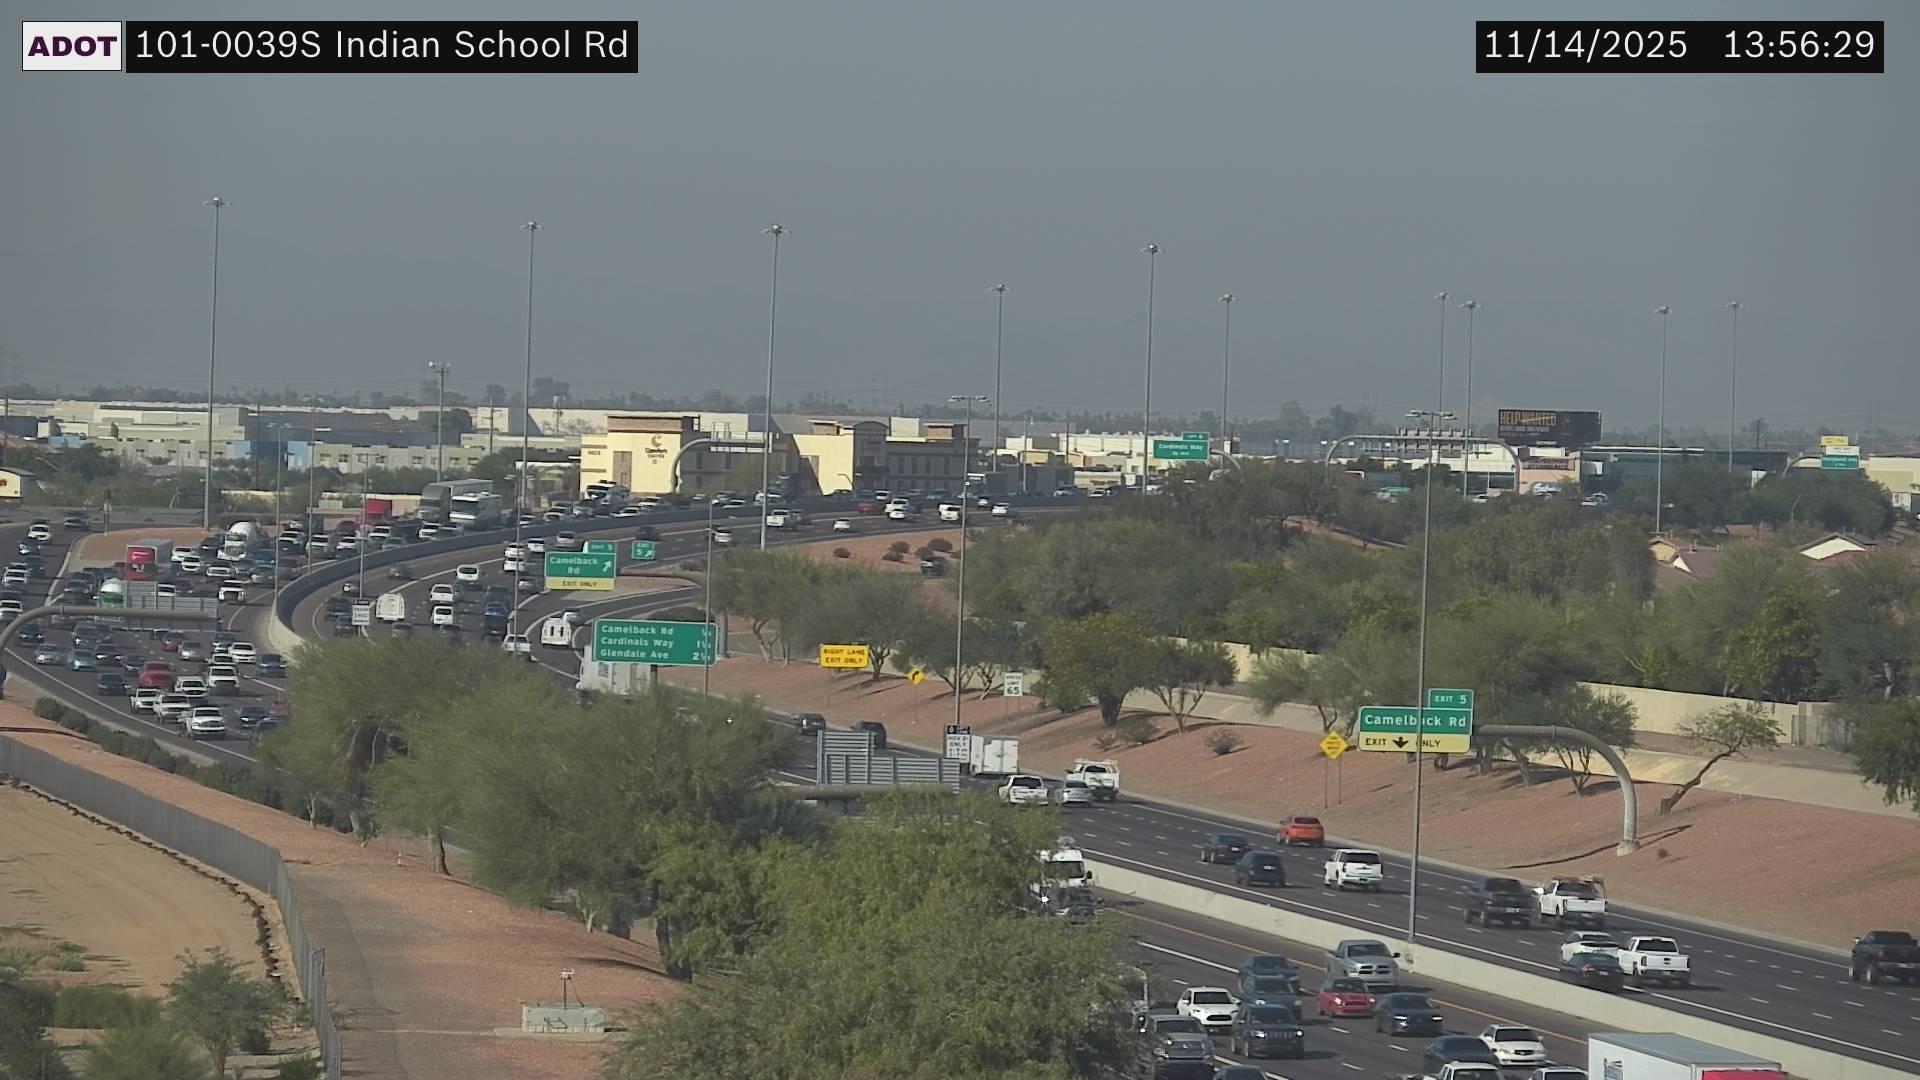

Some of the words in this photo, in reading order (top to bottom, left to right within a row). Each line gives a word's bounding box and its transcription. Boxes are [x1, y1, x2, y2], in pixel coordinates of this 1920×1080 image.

[549, 556, 598, 565] Camelback
[567, 566, 580, 575] Rd
[601, 624, 656, 635] Camelback
[660, 627, 674, 636] Rd
[600, 636, 649, 646] Cardinals
[653, 638, 675, 649] Way
[600, 648, 646, 658] Glendale
[650, 650, 669, 660] Ave
[1007, 686, 1020, 695] 65
[1434, 695, 1454, 703] EXIT
[1459, 694, 1467, 705] 5
[1448, 716, 1467, 728] Rd
[1365, 737, 1387, 746] EXIT
